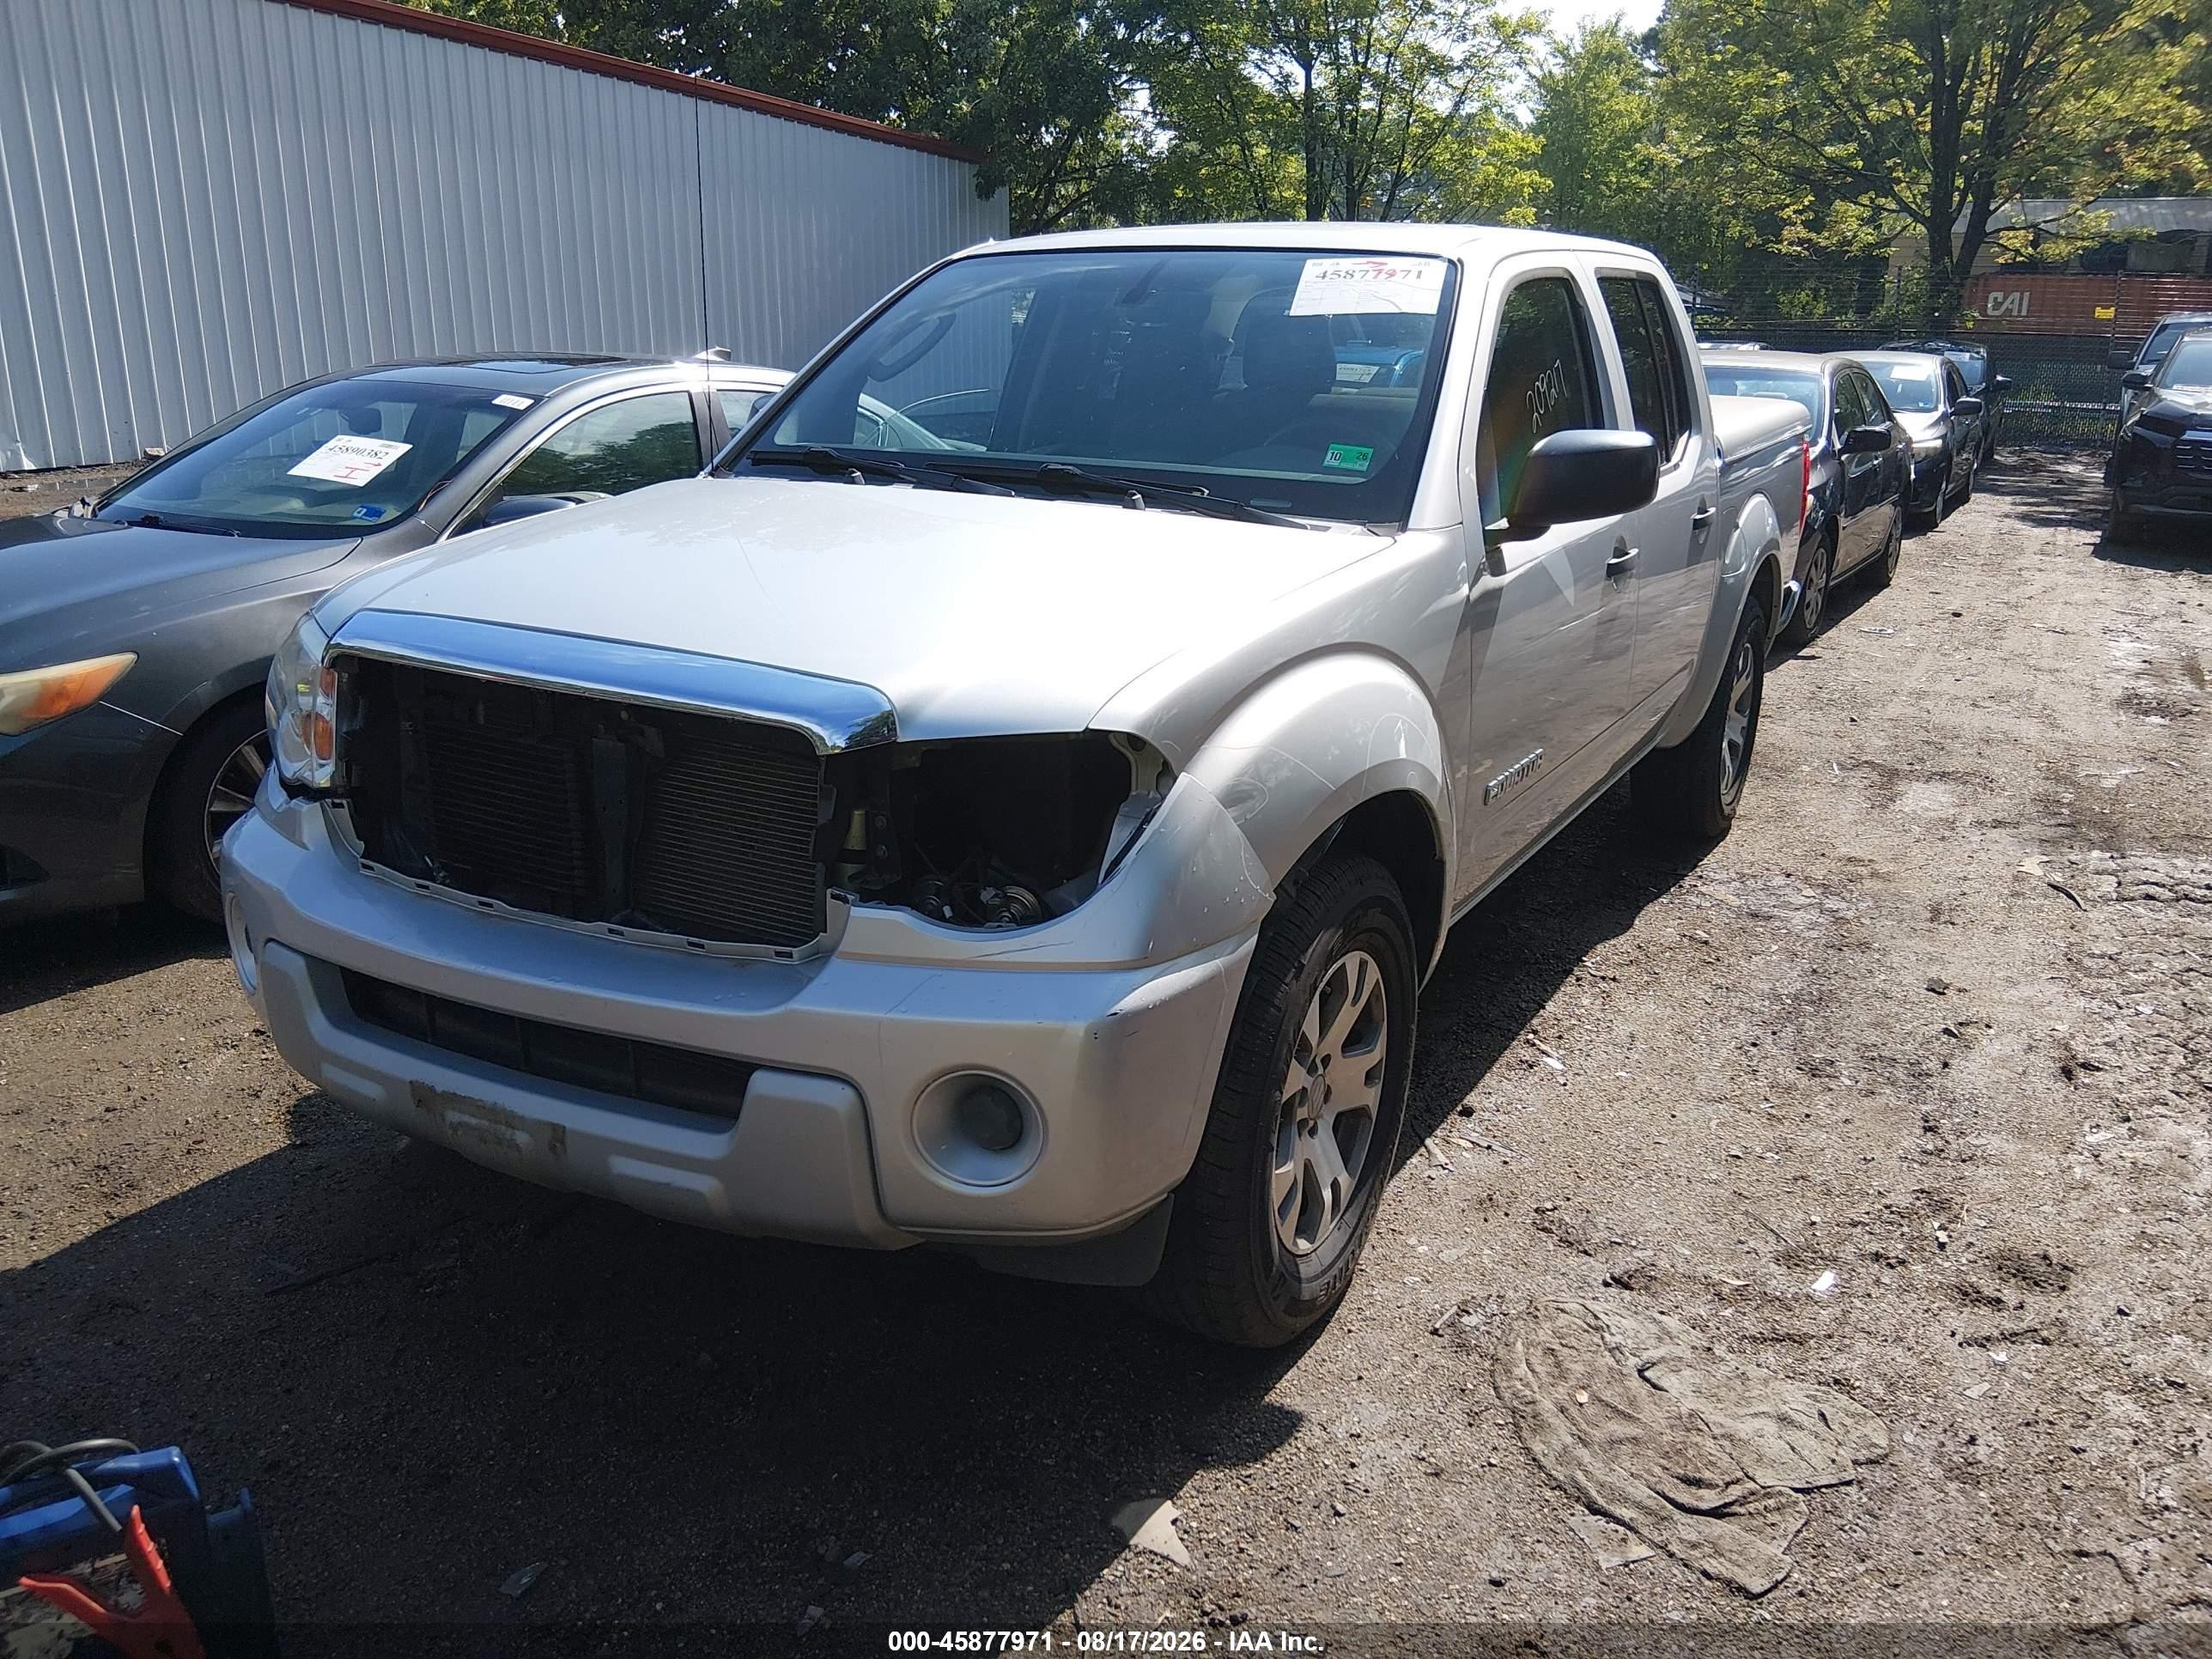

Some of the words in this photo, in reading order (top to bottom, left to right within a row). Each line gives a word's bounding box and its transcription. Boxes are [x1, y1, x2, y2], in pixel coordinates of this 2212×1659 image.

[1316, 268, 1423, 280] 45877971
[1986, 291, 2031, 316] CAI
[328, 444, 390, 460] 45890382
[1329, 451, 1342, 461] 10
[1356, 452, 1369, 461] 26
